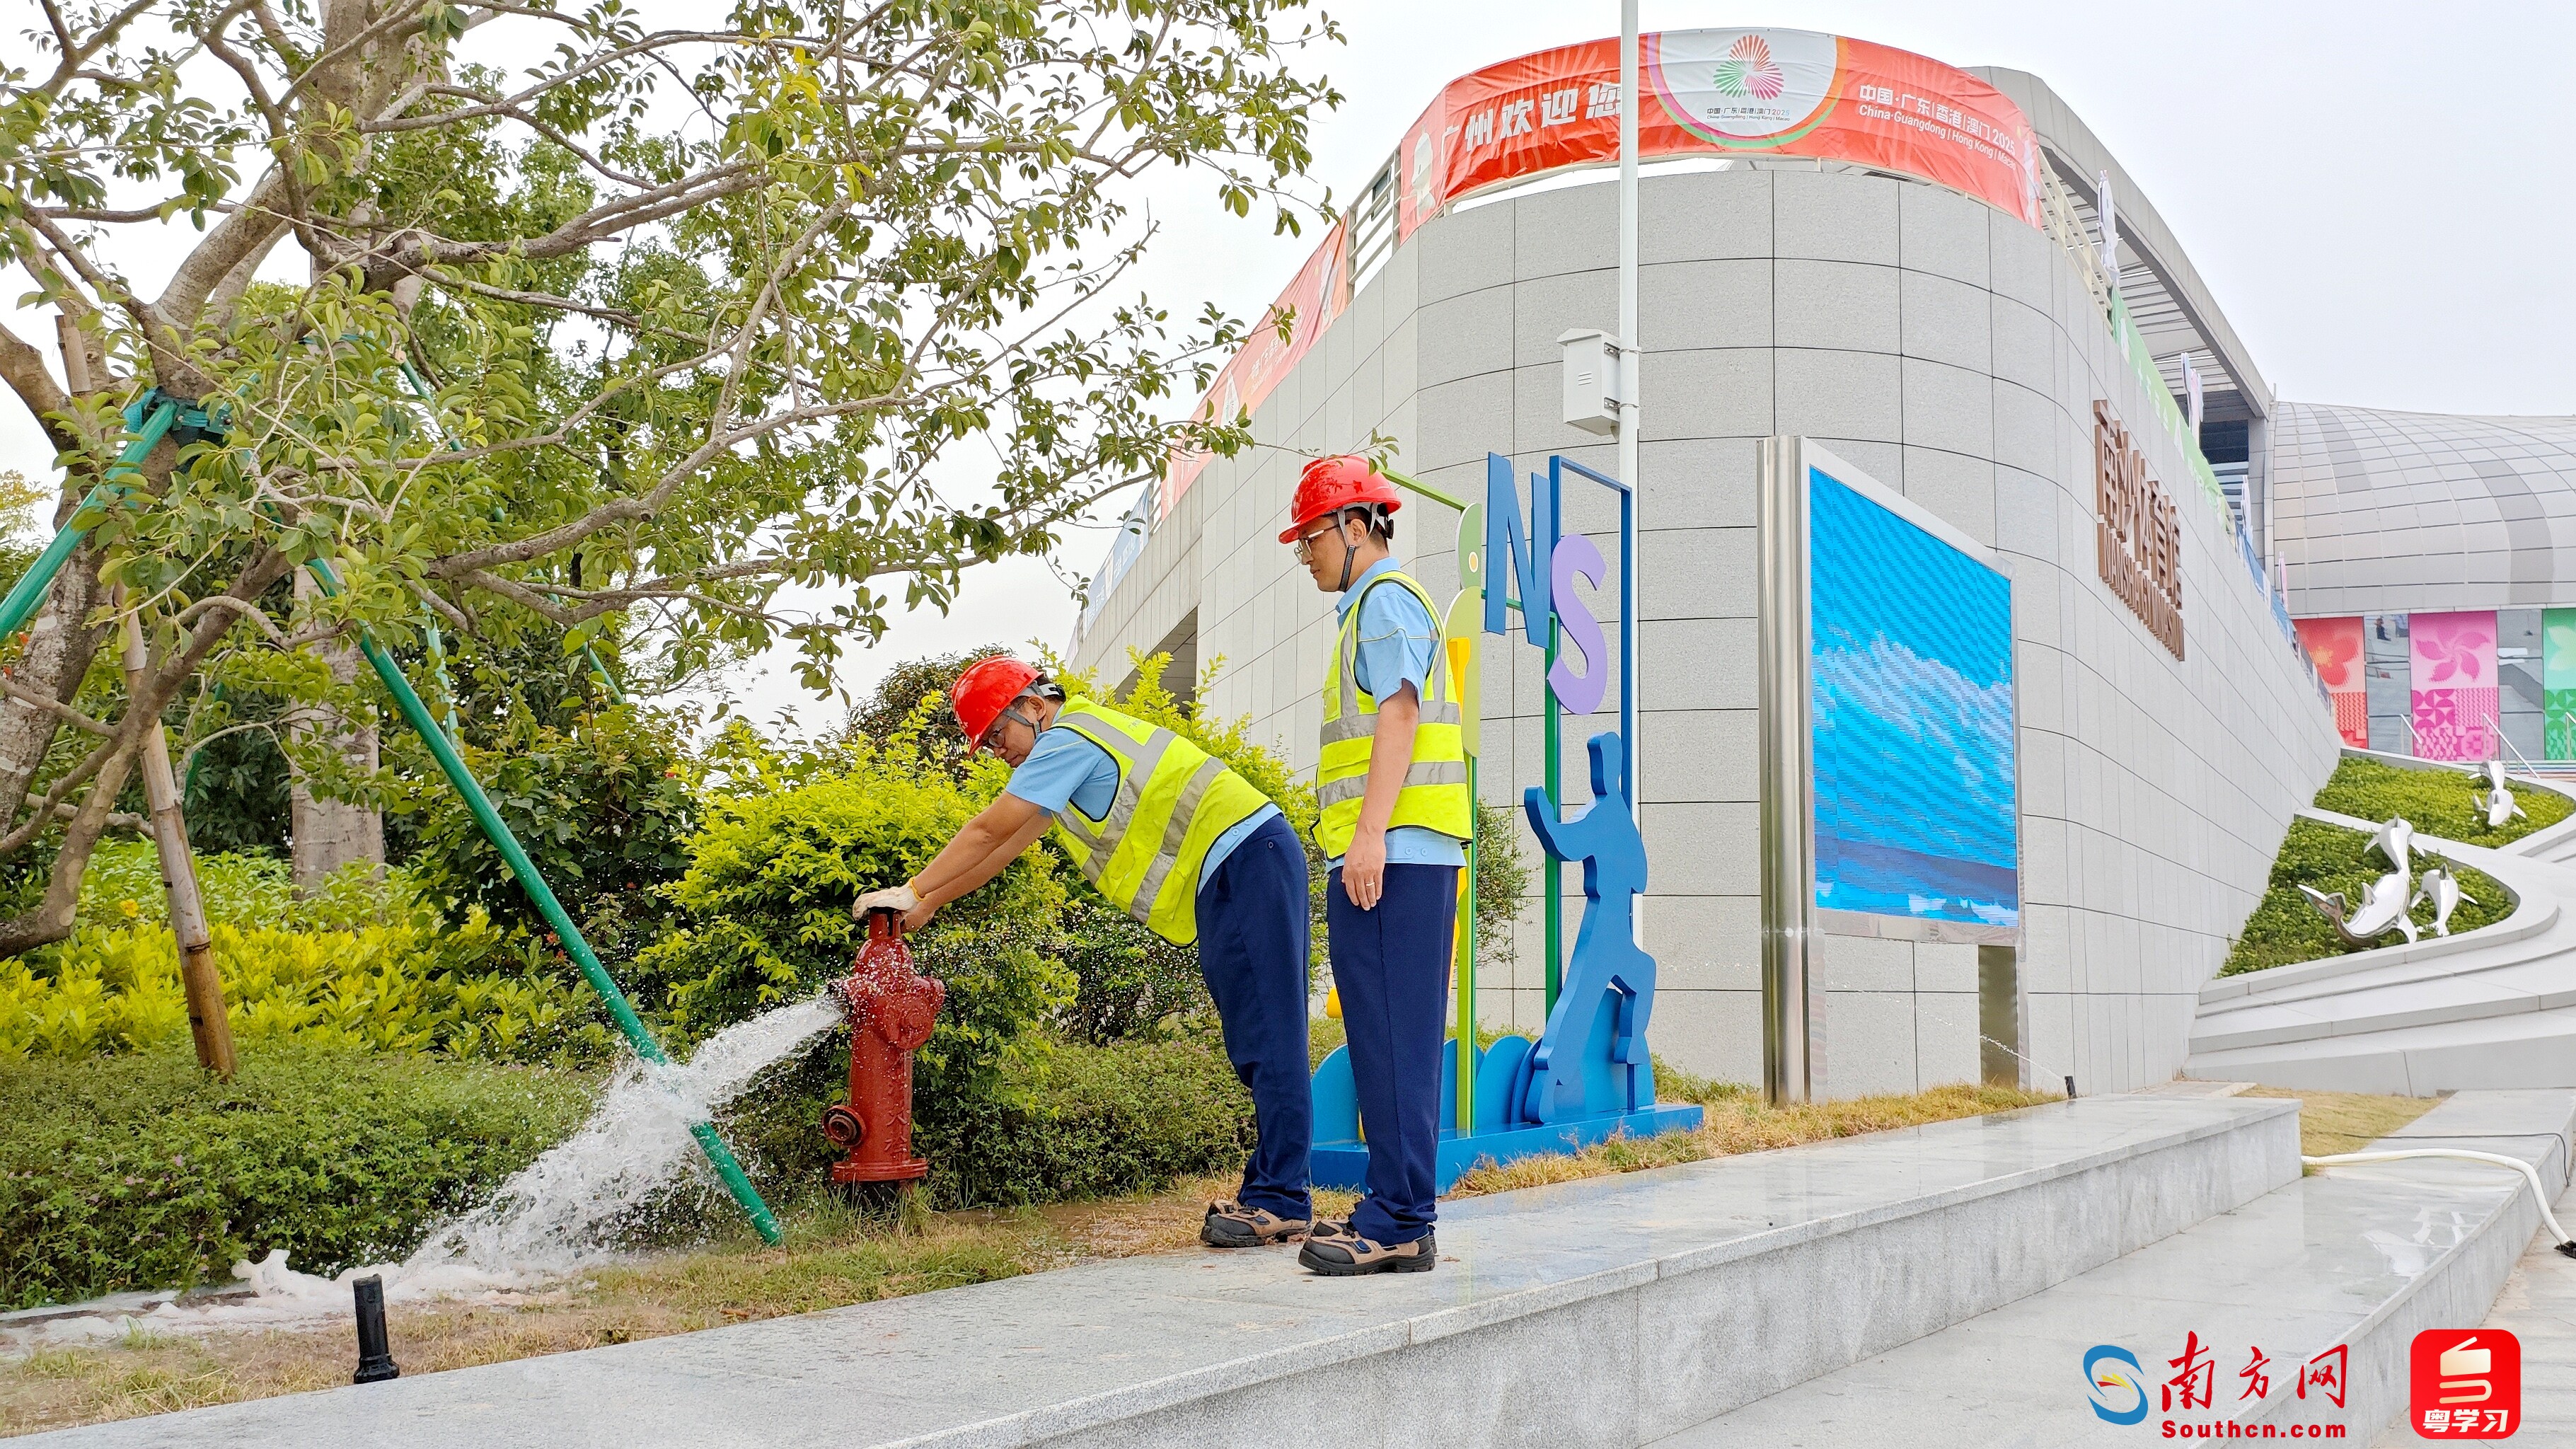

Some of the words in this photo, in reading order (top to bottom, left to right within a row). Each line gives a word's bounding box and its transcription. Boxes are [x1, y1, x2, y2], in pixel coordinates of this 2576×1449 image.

[1440, 83, 1621, 166] 广州欢迎您
[1952, 130, 1973, 150] Hong
[1975, 140, 1993, 159] Kong
[1992, 129, 2016, 156] 2025
[2093, 399, 2183, 610] 南沙体育馆
[2098, 522, 2142, 617] NANSHA
